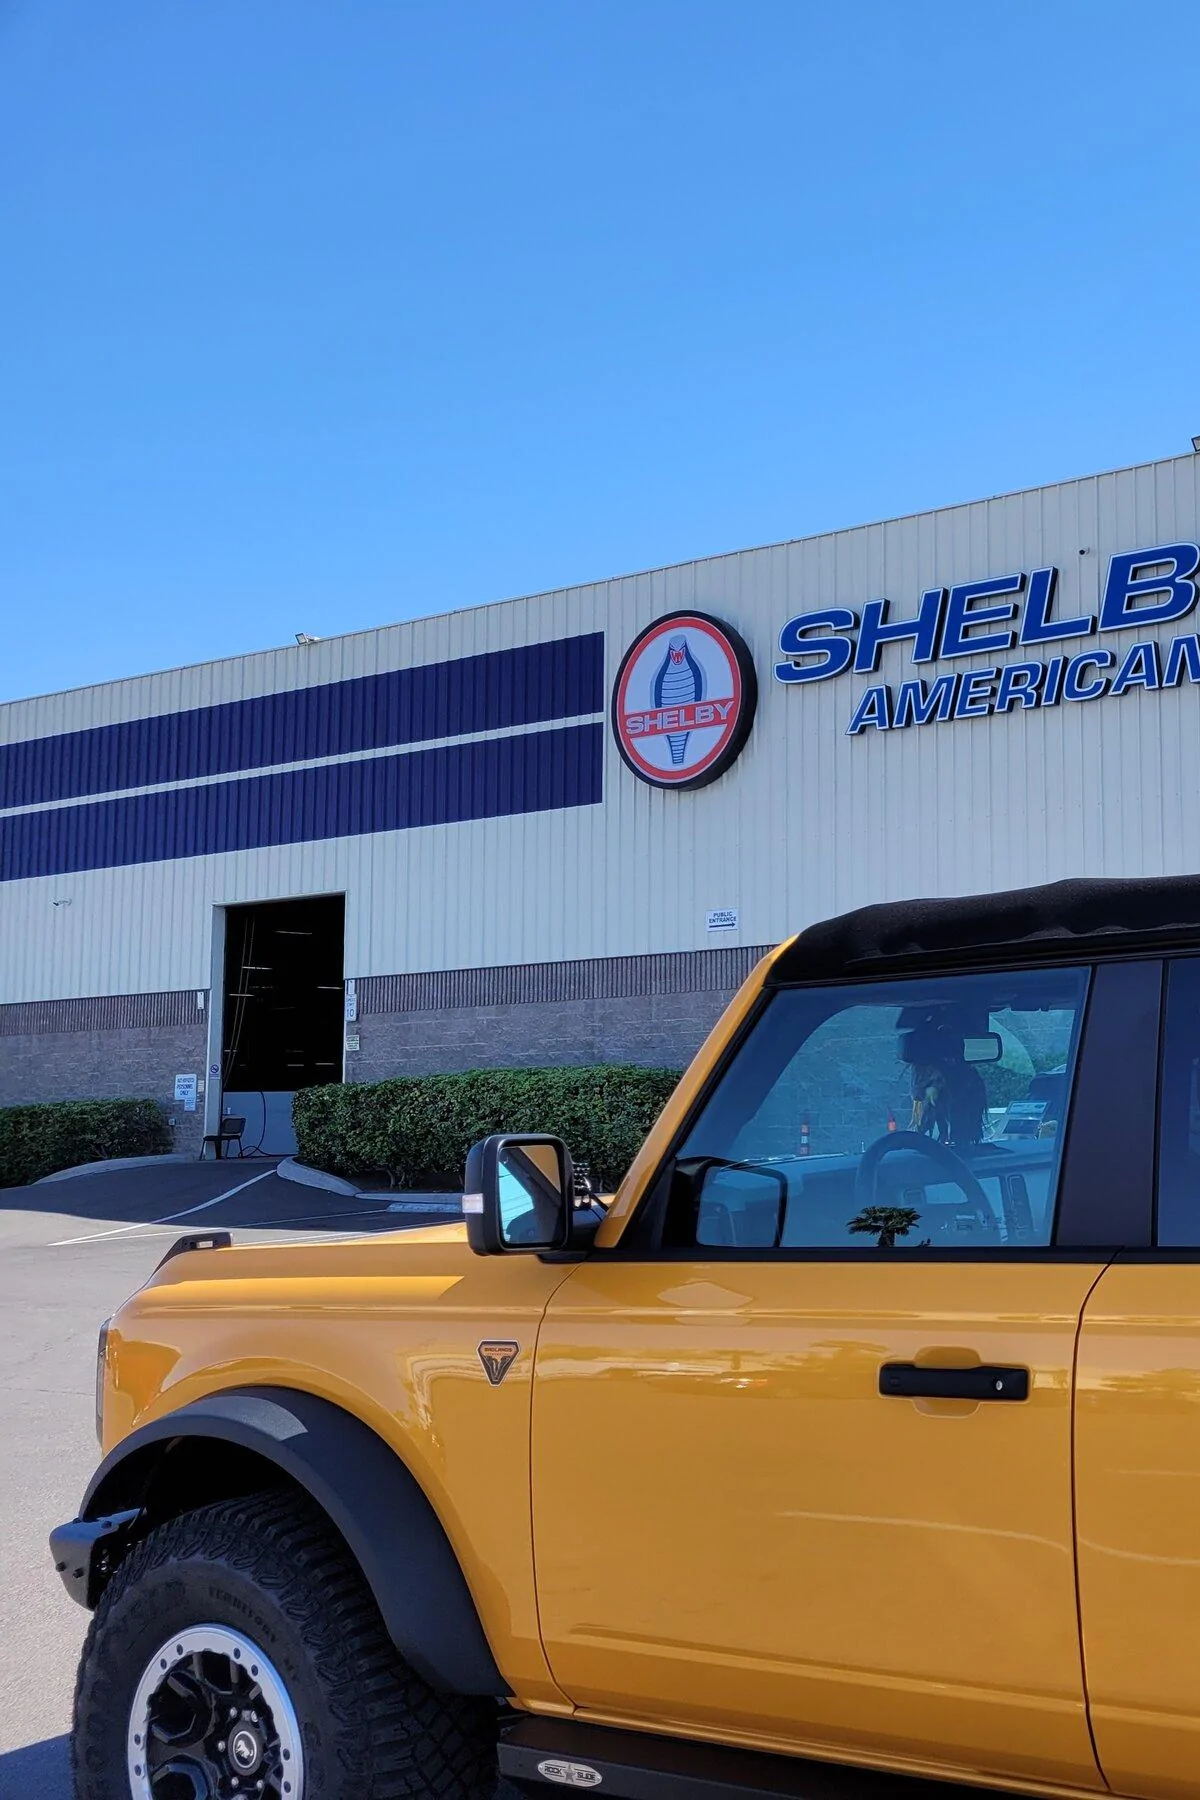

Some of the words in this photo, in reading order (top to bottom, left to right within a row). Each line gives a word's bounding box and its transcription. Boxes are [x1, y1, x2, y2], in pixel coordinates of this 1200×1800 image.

[626, 701, 735, 735] SHELBY
[709, 916, 737, 924] ENTRANCE
[346, 1008, 356, 1018] 10
[544, 1765, 562, 1775] ROCK
[576, 1771, 597, 1781] SLIDE
